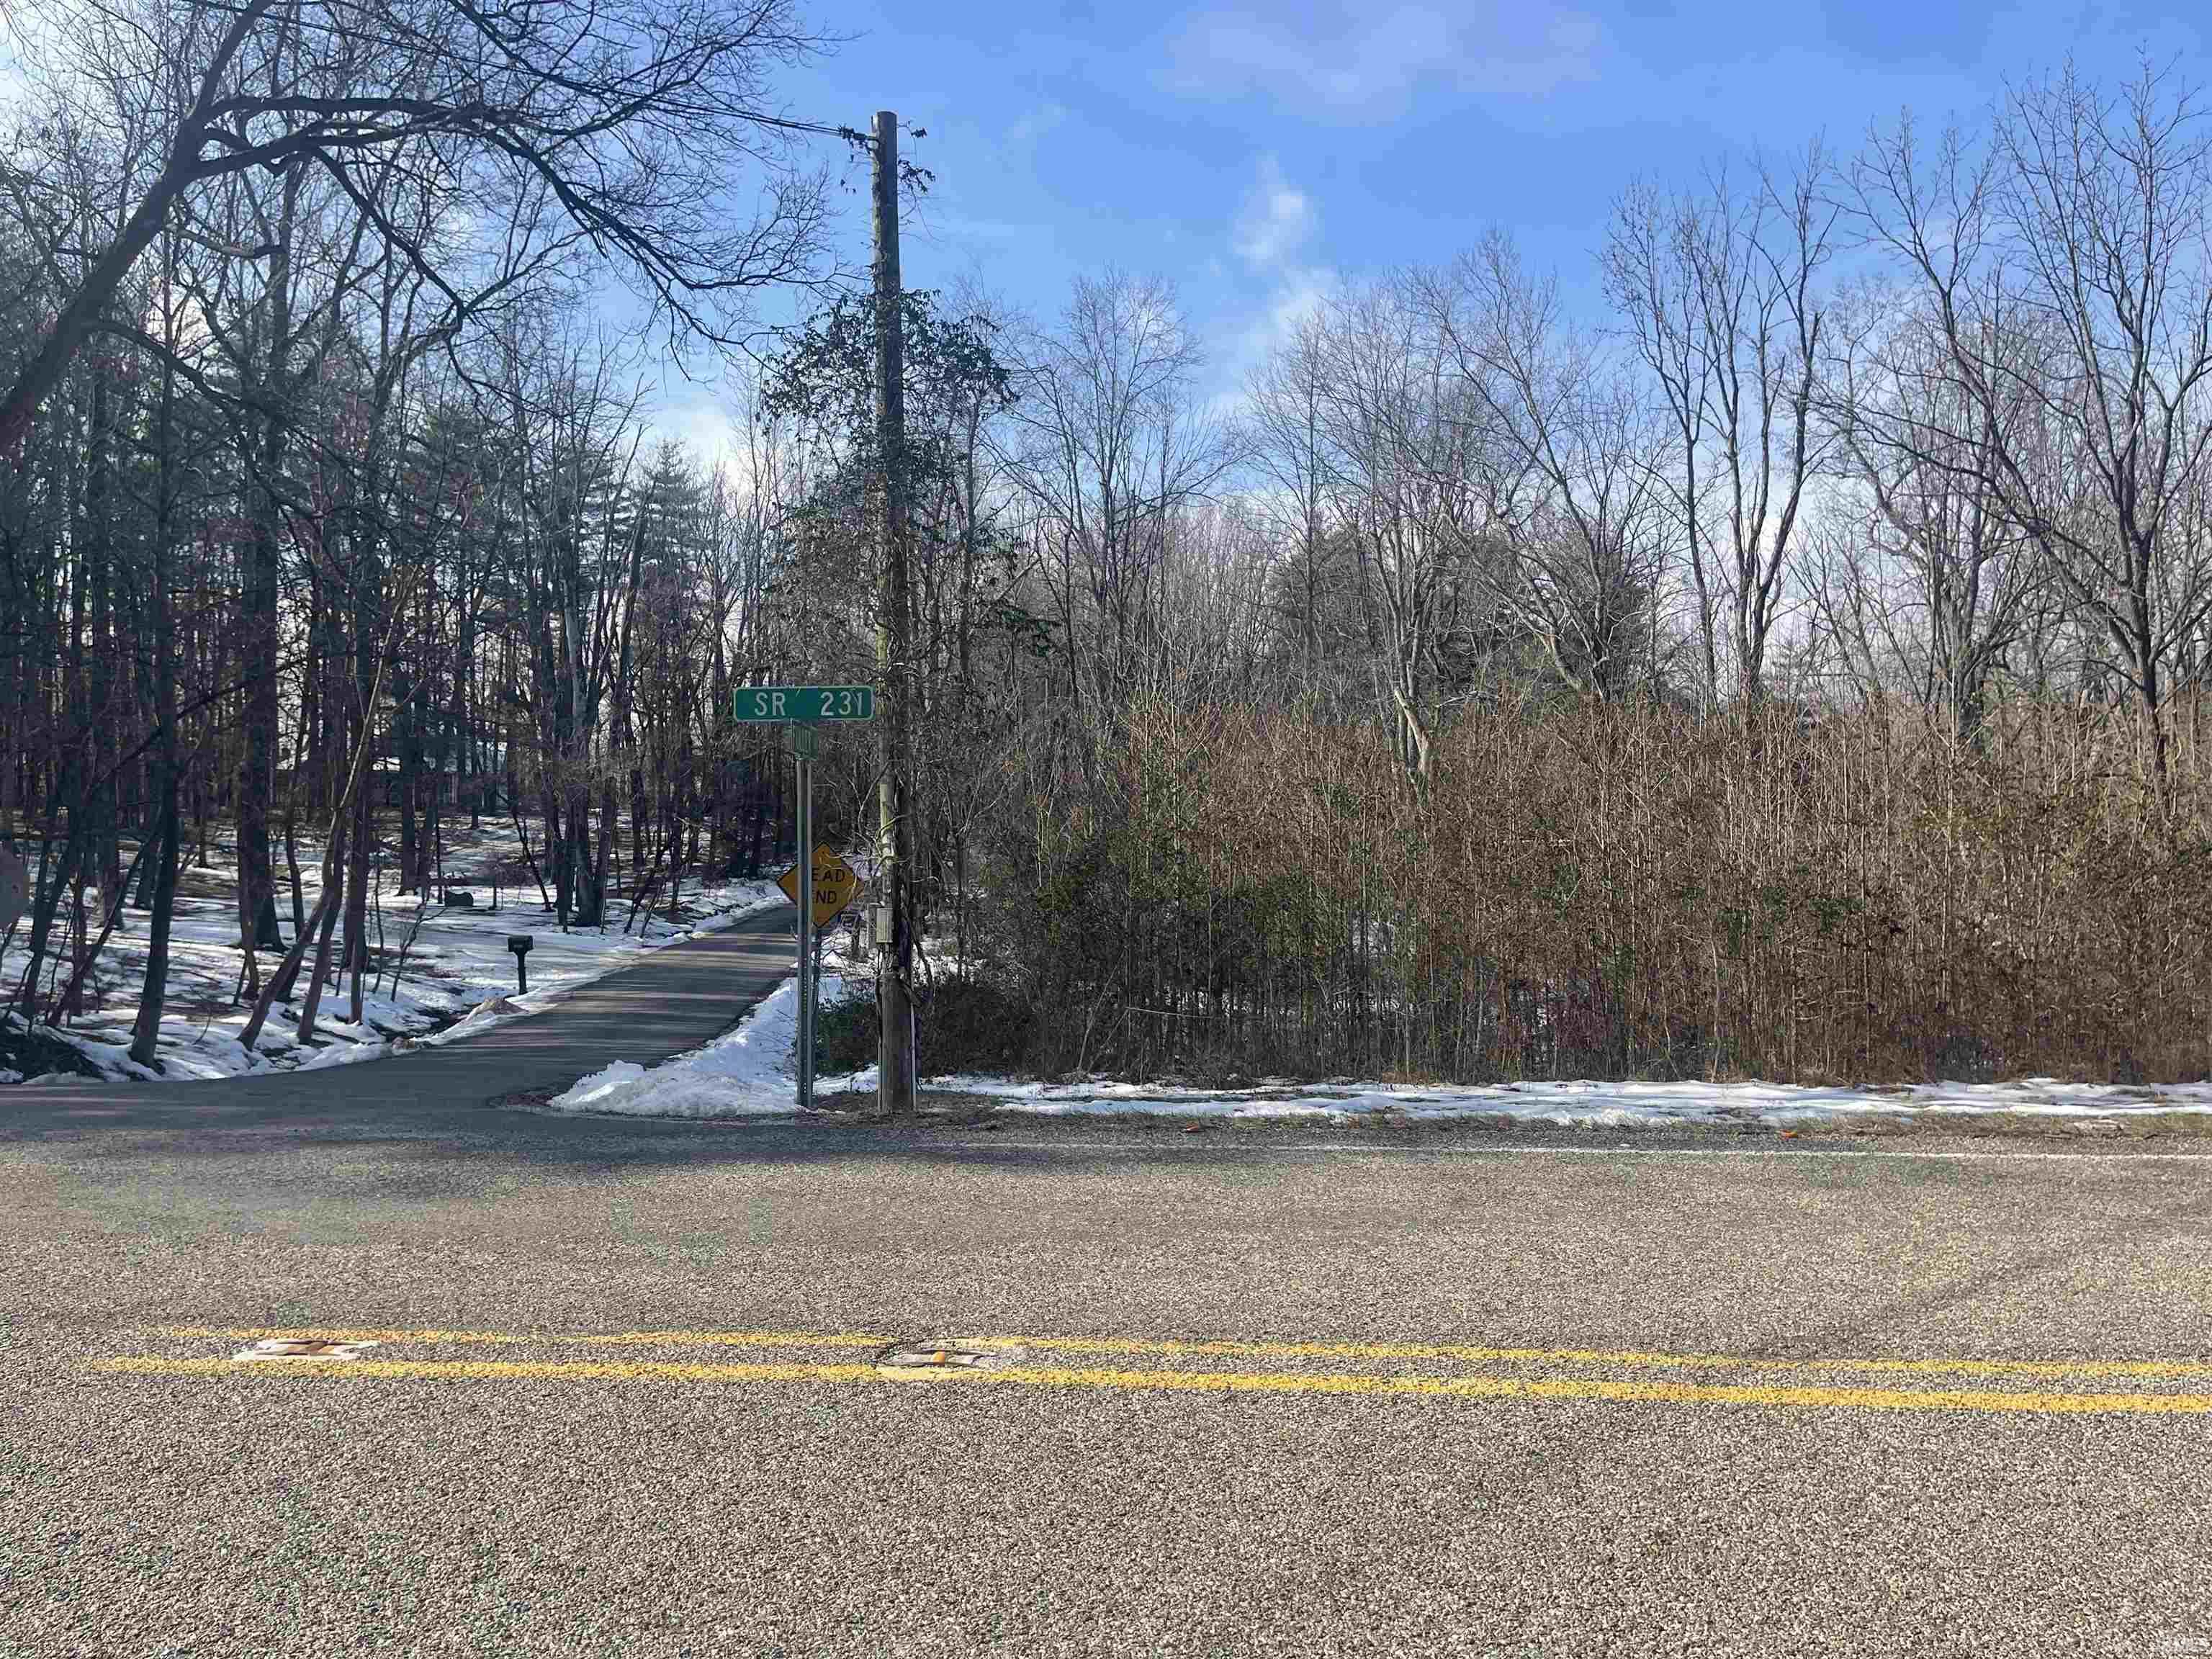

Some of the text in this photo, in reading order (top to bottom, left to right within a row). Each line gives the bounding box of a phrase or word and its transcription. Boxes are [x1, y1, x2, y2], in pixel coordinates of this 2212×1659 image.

[755, 691, 863, 716] SR 231
[811, 868, 845, 882] EAD
[811, 890, 837, 904] ND
